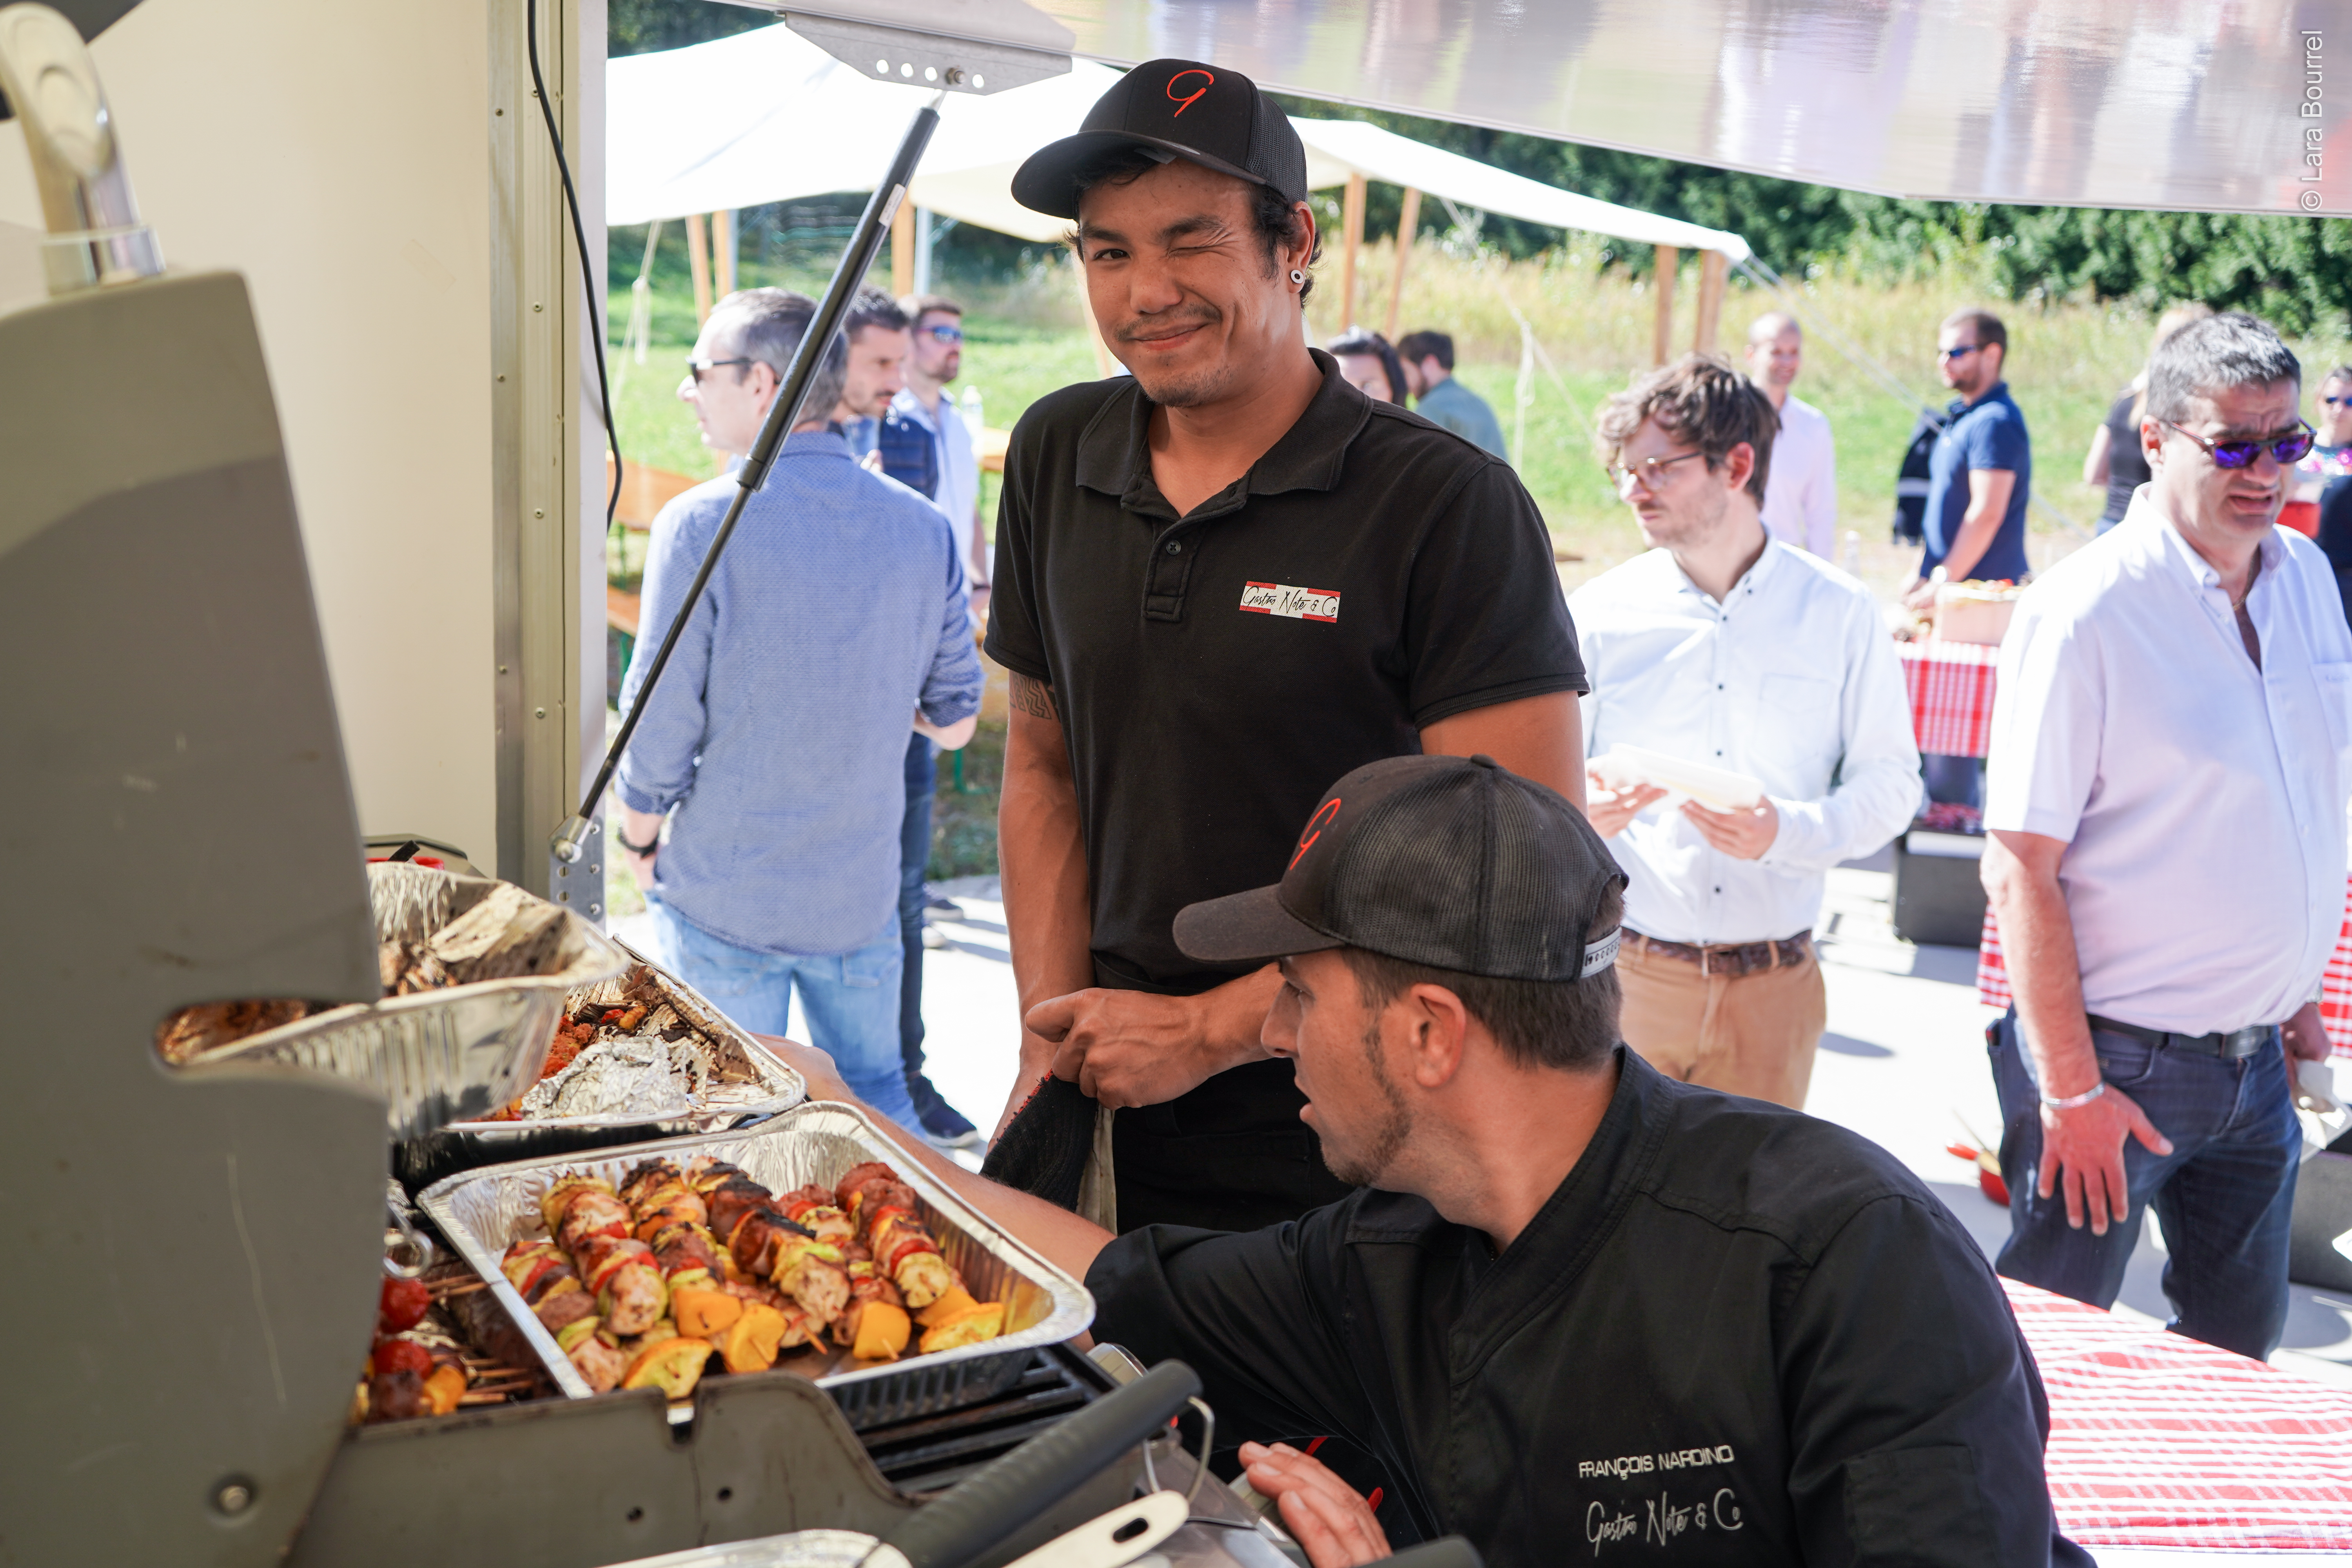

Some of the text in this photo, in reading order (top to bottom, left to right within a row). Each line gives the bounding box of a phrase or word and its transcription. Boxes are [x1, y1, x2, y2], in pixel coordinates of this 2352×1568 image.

[1243, 585, 1338, 617] Gastro Note & Co
[1579, 1445, 1735, 1480] FRANÇOIS NARDINO
[1586, 1501, 1638, 1557] Gastro
[1713, 1488, 1744, 1530] Co
